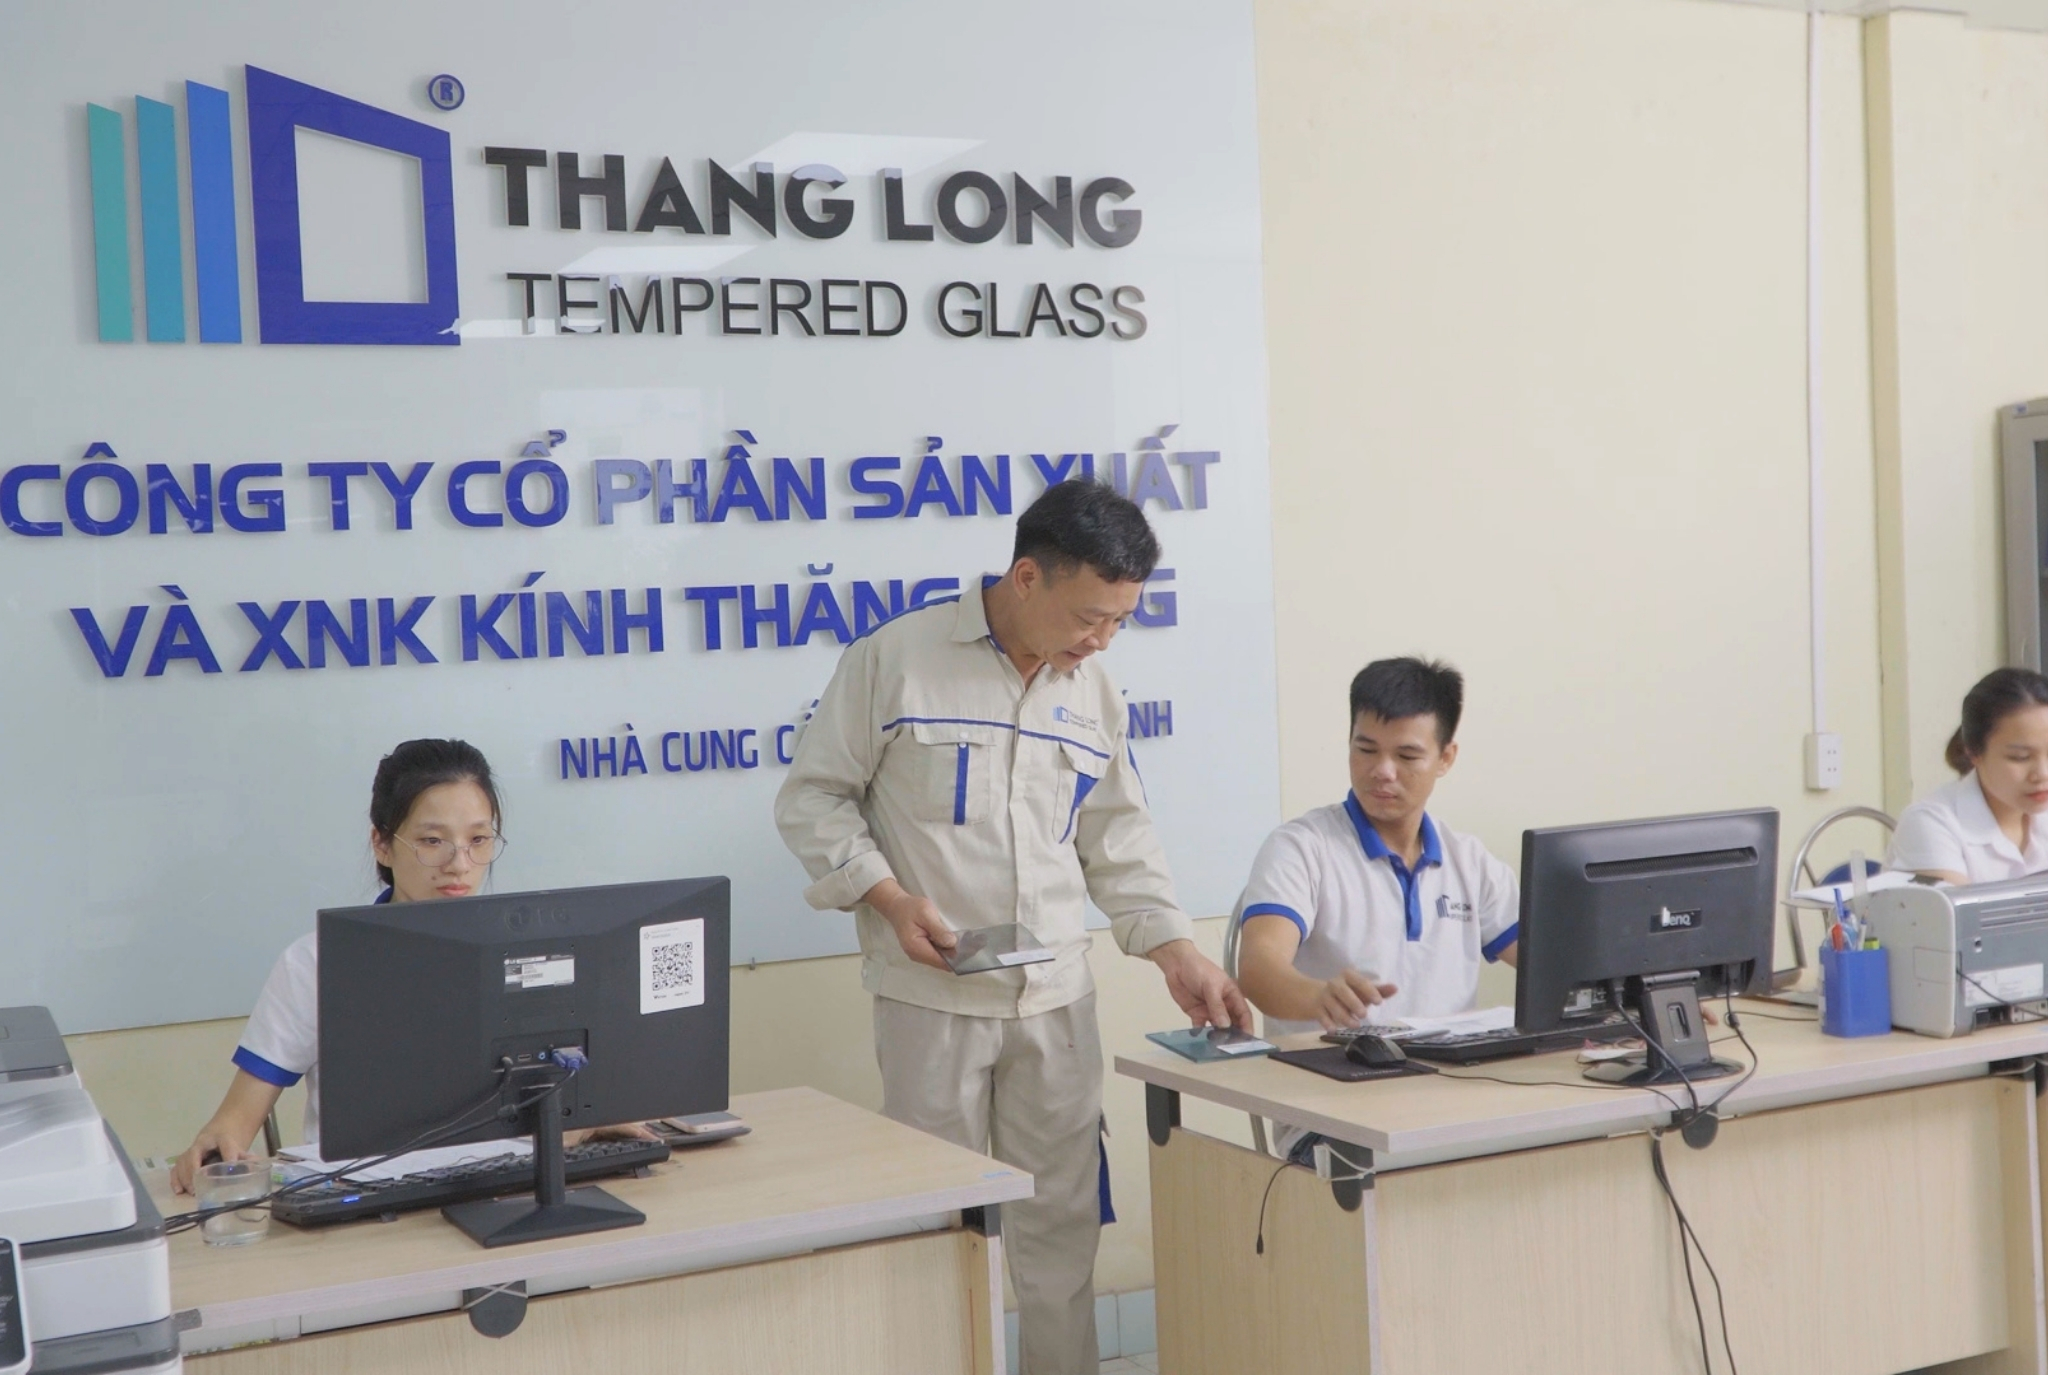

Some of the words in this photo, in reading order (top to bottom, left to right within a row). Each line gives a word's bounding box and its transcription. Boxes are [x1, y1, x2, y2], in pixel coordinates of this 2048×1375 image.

[482, 146, 855, 239] THANG
[884, 167, 1143, 249] LONG
[506, 272, 908, 337] TEMPERED
[936, 280, 1149, 341] GLASS
[0, 442, 286, 536] CÔNG
[308, 461, 435, 531] TY
[447, 429, 571, 528] CỔ
[595, 429, 828, 525] PHẦN
[849, 436, 1013, 519] SẢN
[70, 585, 222, 678] VÀ
[236, 595, 439, 673] XNK
[459, 571, 665, 662] KÍNH
[560, 723, 648, 779] NHÀ
[661, 729, 759, 773] CUNG
[1662, 911, 1692, 928] enQ
